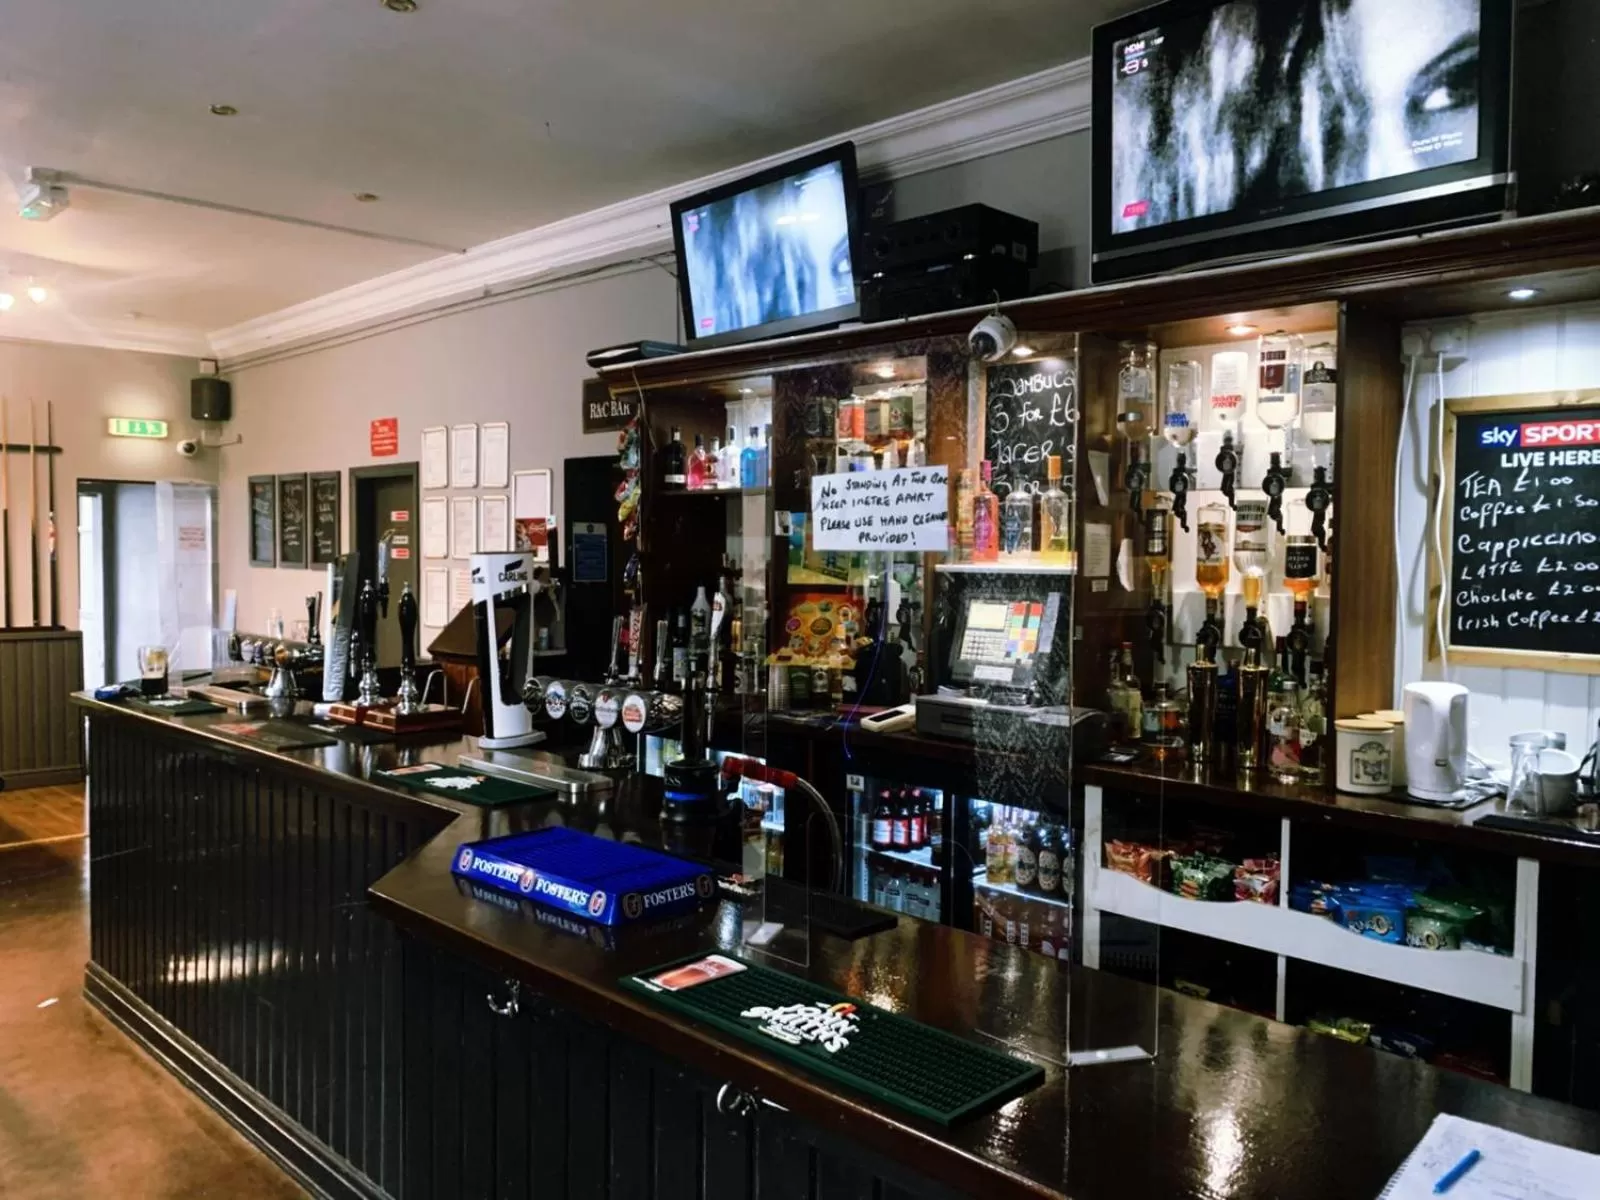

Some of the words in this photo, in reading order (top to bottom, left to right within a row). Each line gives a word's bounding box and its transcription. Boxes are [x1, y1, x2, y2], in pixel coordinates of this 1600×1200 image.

[1481, 426, 1518, 447] sky
[1501, 451, 1545, 468] LIVE
[1548, 449, 1600, 466] HERE
[1459, 470, 1502, 499] TEA
[855, 516, 873, 528] USE
[1460, 560, 1523, 580] LATTE
[535, 878, 591, 906] FOSTER'S
[643, 881, 696, 909] FOSTER'S
